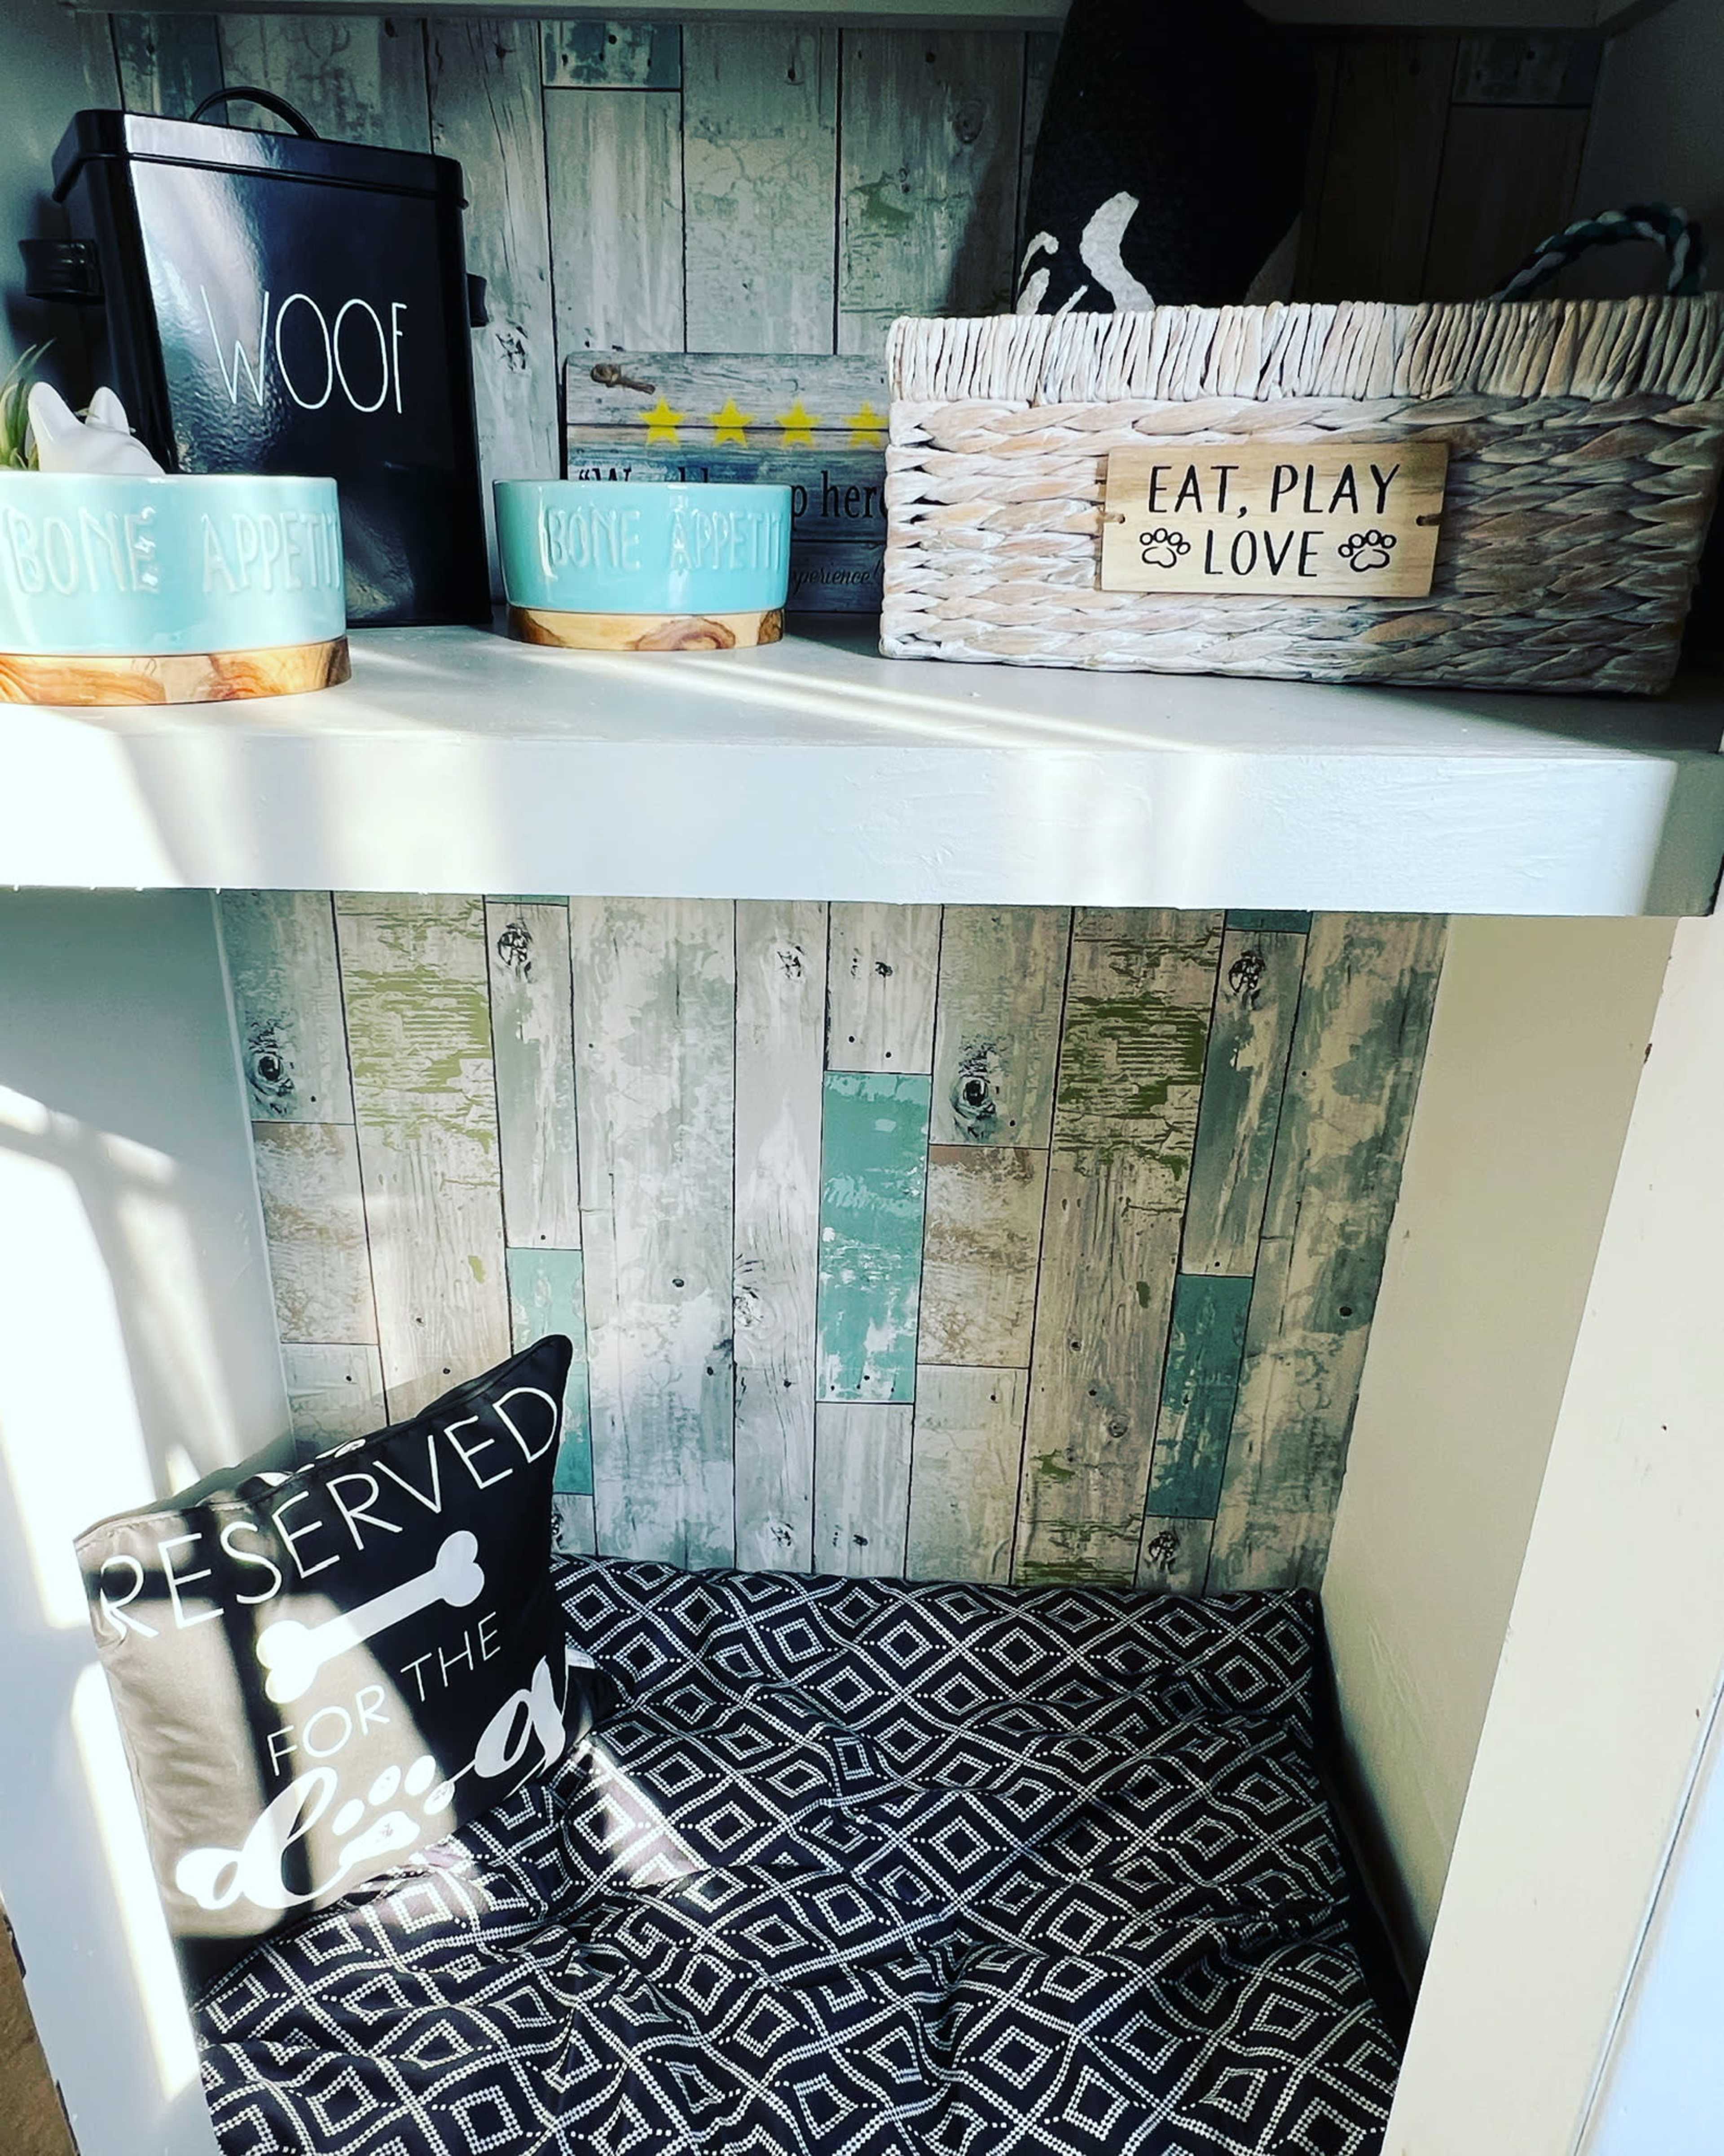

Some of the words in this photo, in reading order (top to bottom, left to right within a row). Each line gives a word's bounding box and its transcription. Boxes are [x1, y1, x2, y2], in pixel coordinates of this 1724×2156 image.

[200, 284, 408, 414] WOOF
[546, 502, 642, 571] BONE
[1148, 463, 1248, 519] EAT,
[1270, 463, 1400, 514] PLAY
[3, 504, 160, 596] BONE
[1204, 529, 1324, 578] LOVE
[99, 1385, 558, 1639] RESERVED
[267, 1684, 390, 1777] FOR
[400, 1610, 501, 1702] THE
